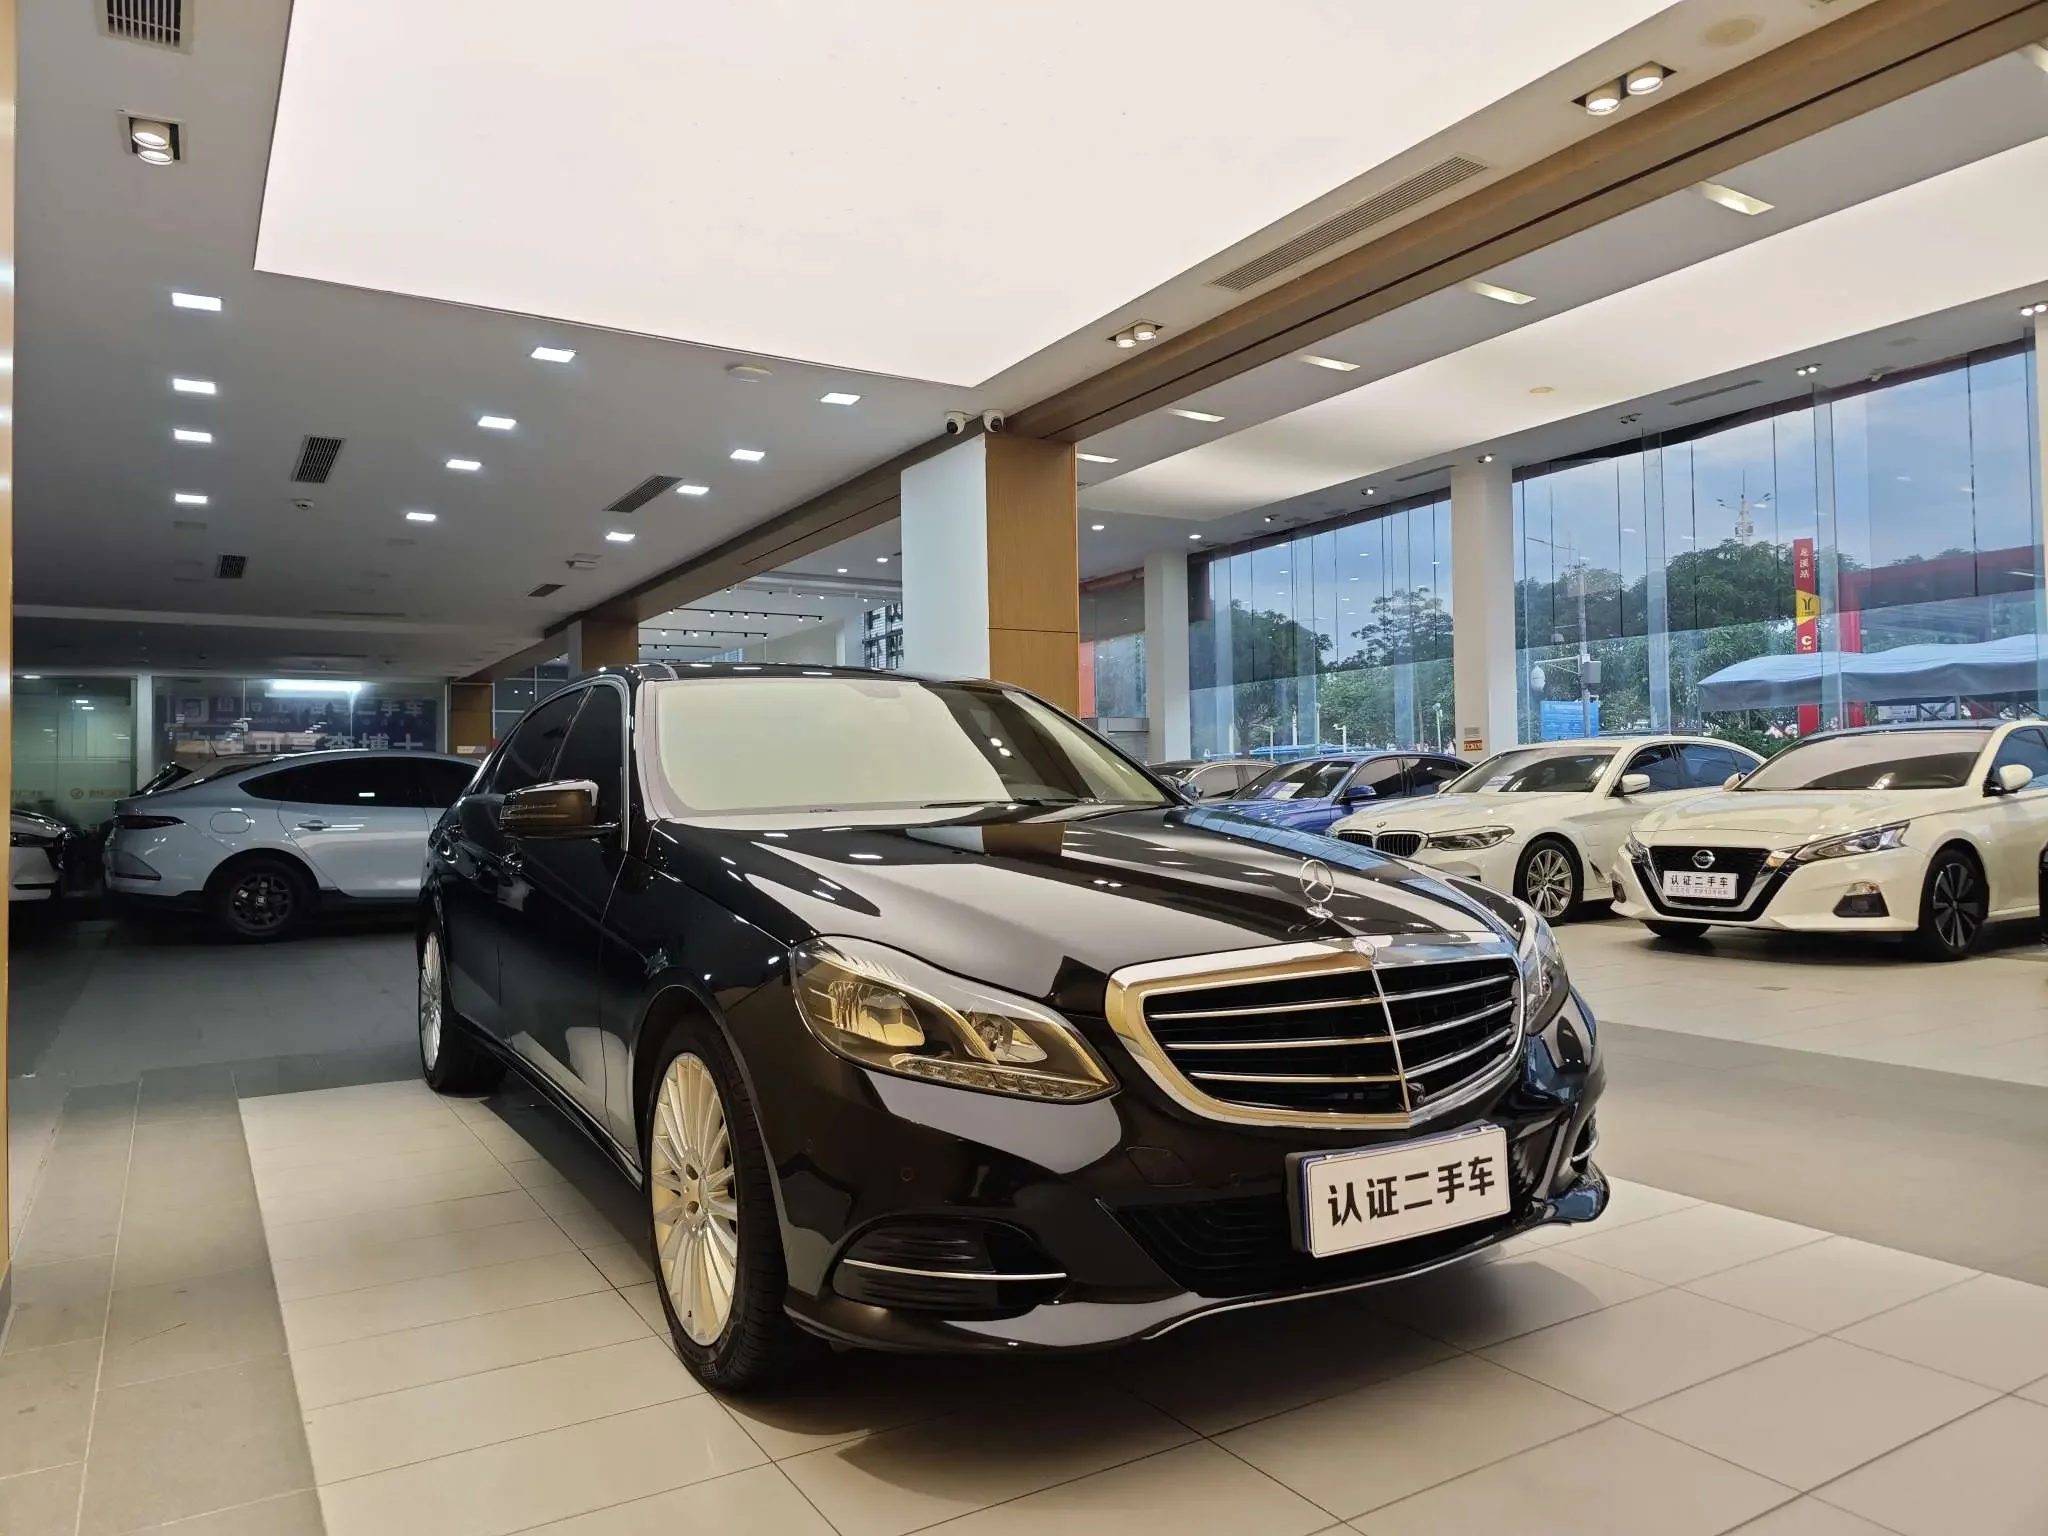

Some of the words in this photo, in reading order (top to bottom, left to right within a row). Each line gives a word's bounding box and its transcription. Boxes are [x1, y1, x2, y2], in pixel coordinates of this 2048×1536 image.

[1671, 874, 1729, 887] 认证二手车
[1328, 1156, 1494, 1226] 认证二手车
